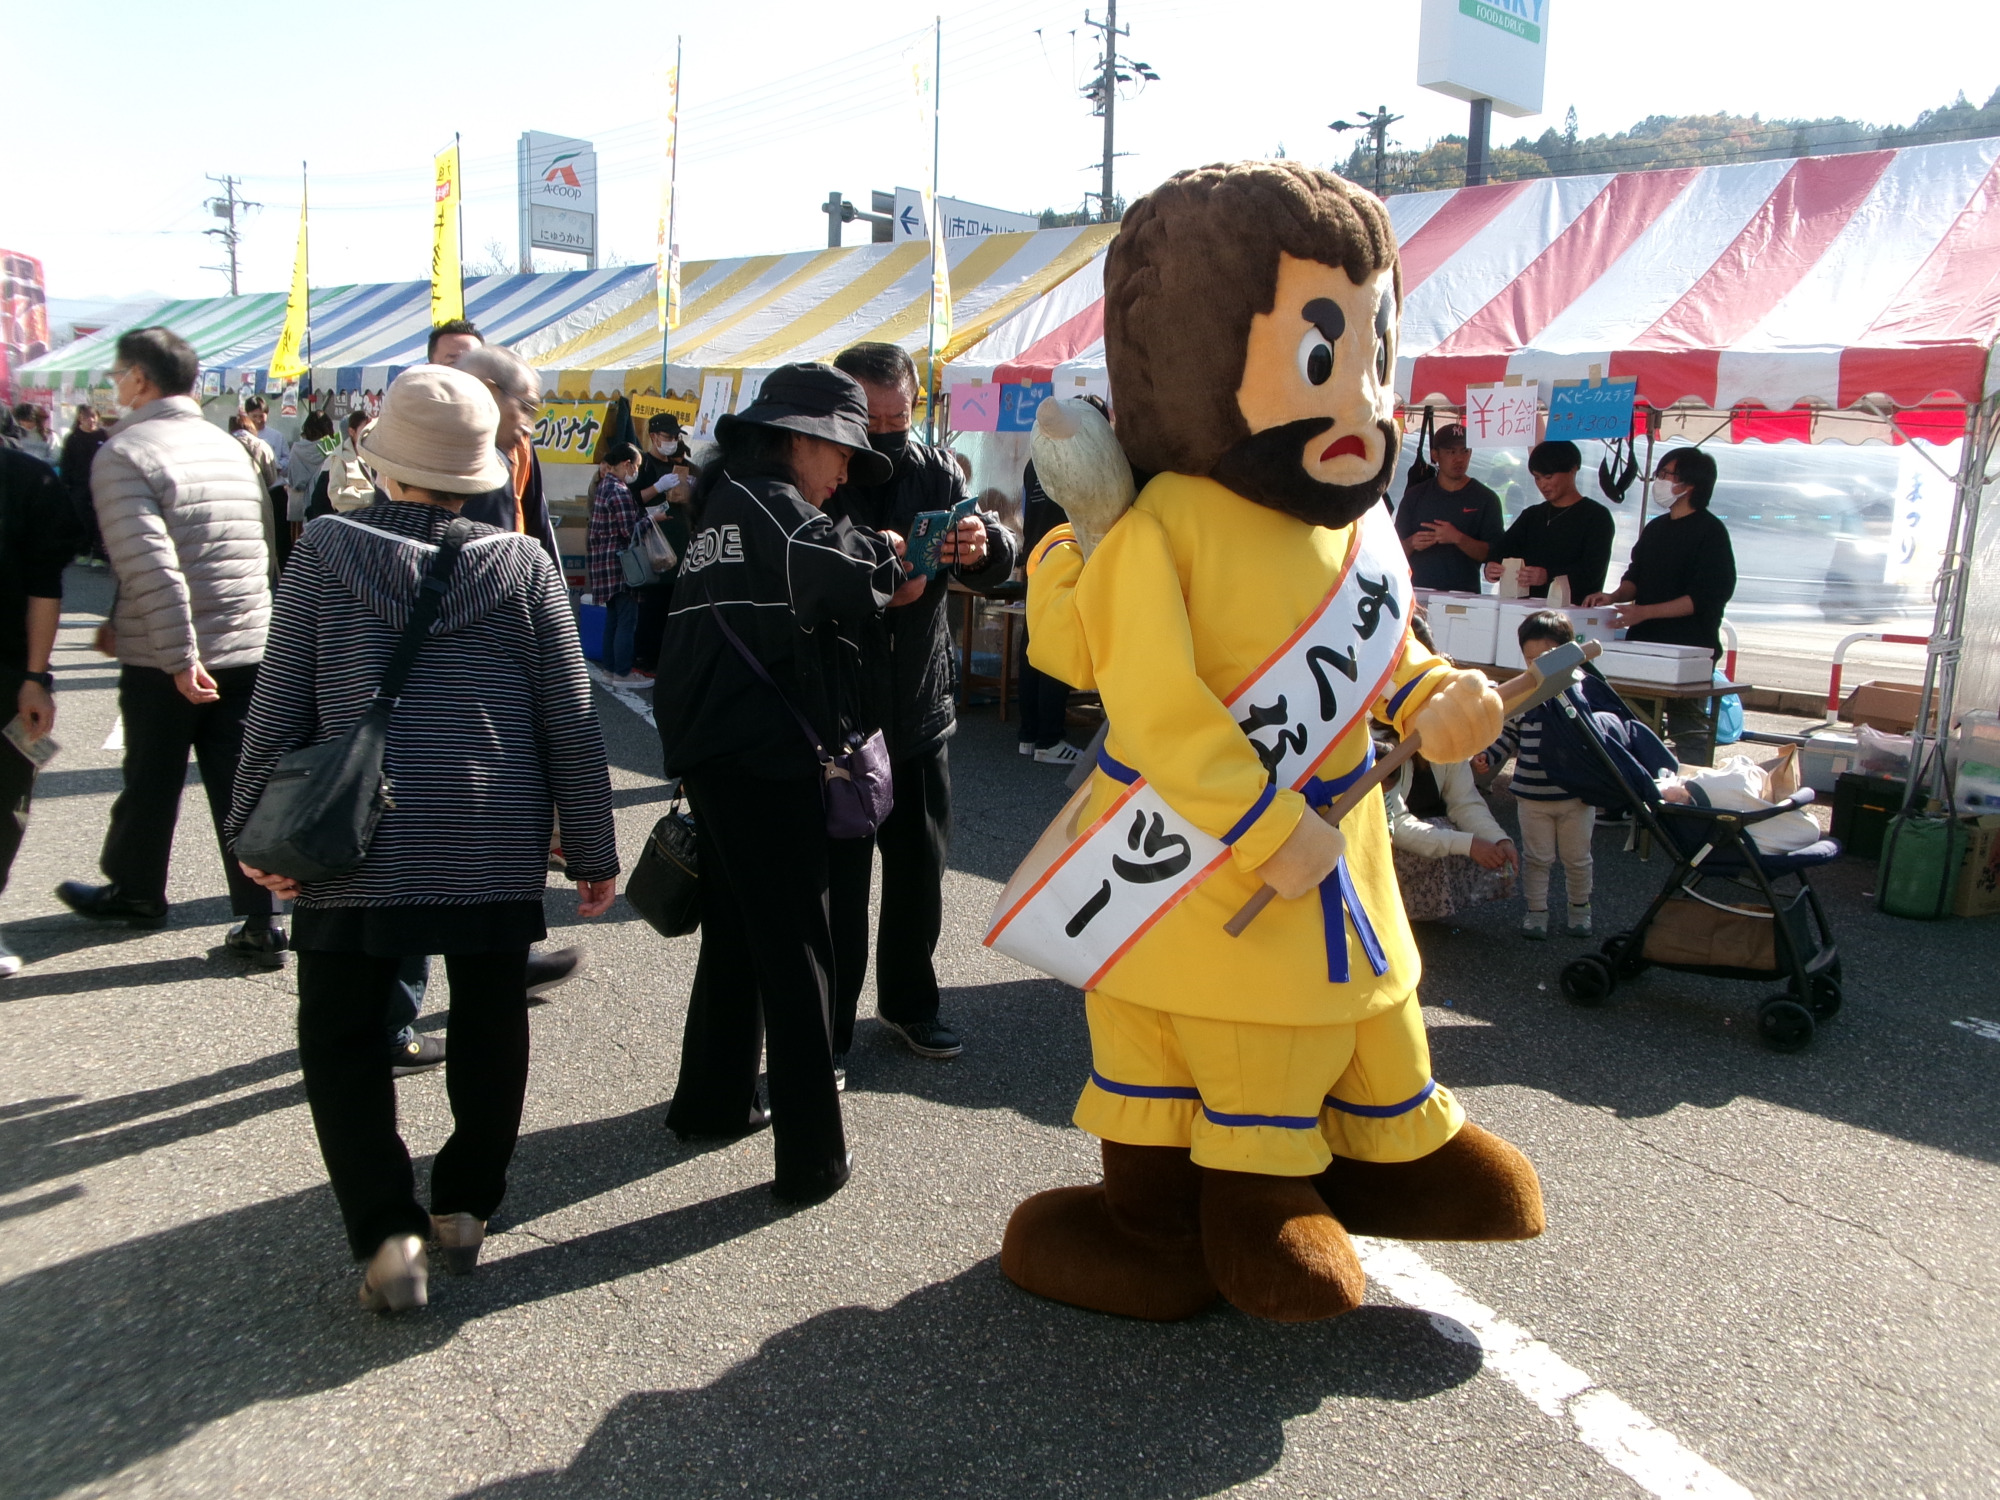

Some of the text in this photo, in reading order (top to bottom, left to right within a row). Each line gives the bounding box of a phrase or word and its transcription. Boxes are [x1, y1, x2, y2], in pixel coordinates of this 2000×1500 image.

[540, 229, 585, 245] にゅうかわ
[1556, 389, 1633, 404] ベビーカステラ
[1900, 472, 1923, 564] まつり
